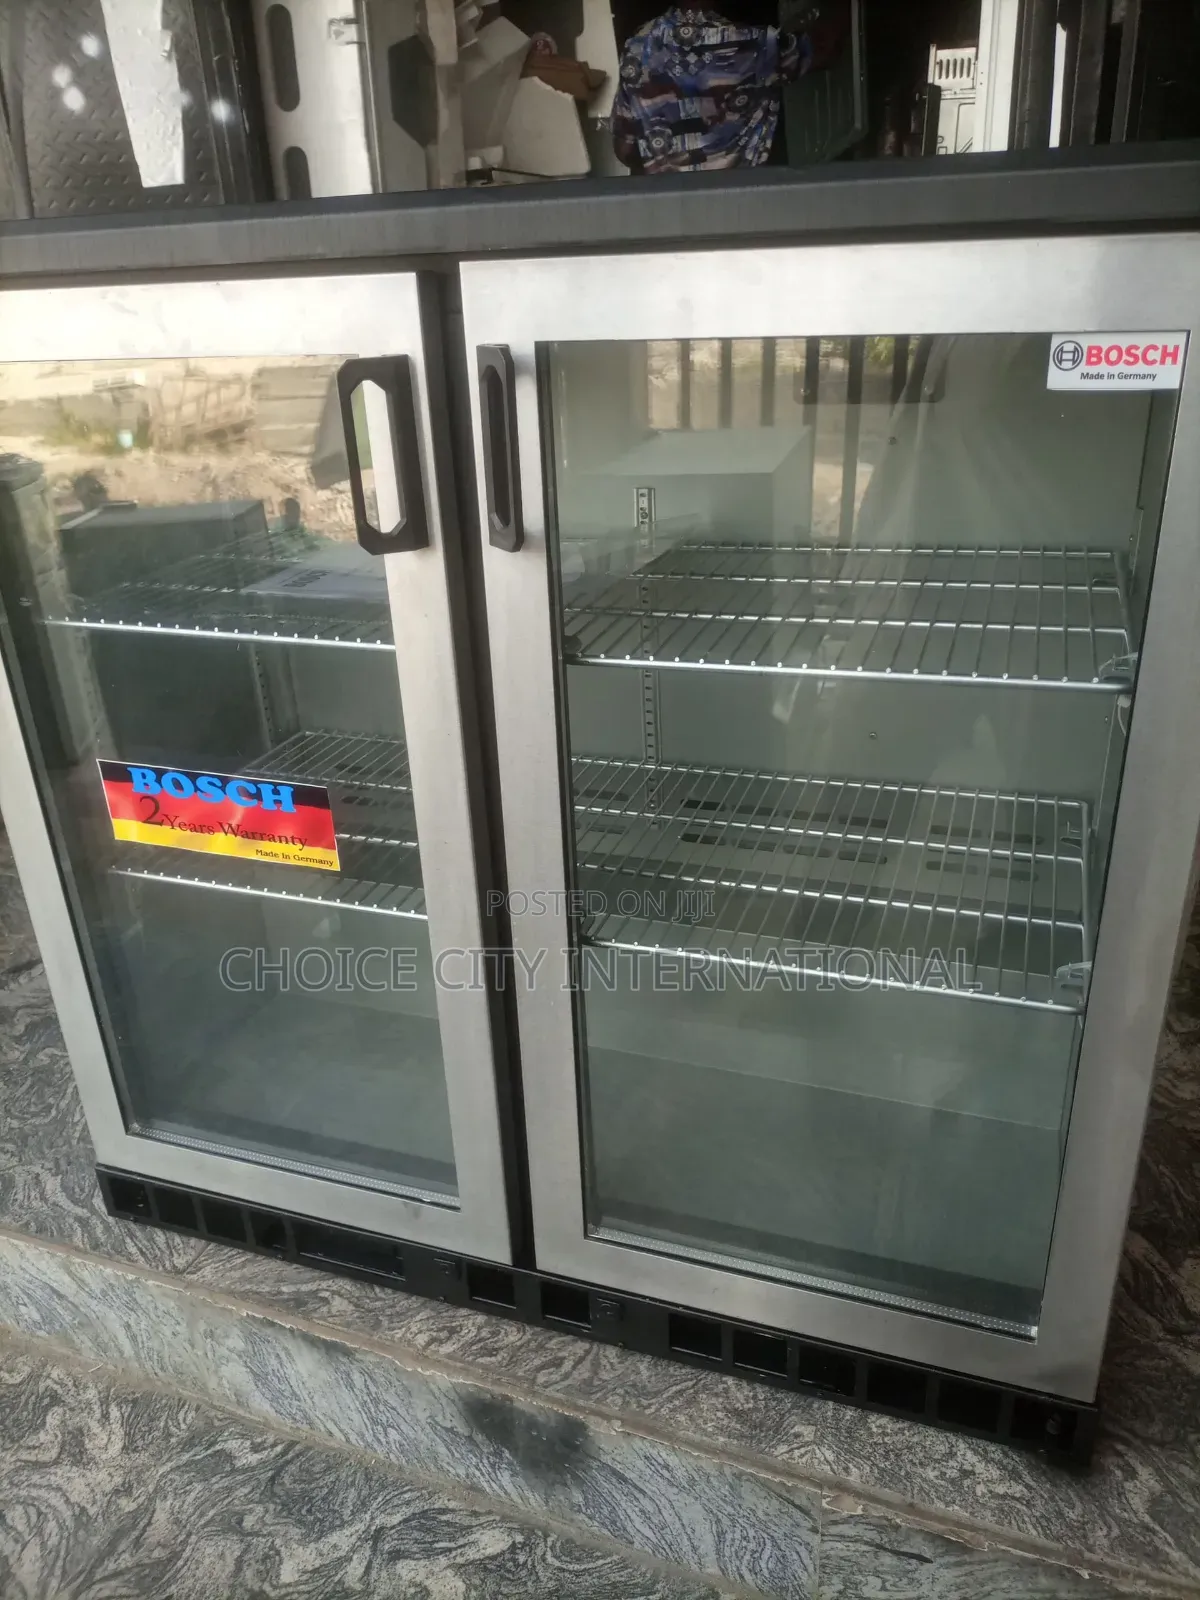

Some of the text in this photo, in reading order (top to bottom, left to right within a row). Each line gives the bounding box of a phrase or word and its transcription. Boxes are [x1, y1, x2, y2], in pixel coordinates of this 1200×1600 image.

[1085, 344, 1180, 366] BOSCH
[1080, 372, 1105, 380] Made
[1117, 372, 1157, 381] Germany
[127, 767, 296, 813] BOSCH
[217, 821, 308, 851] Warranty
[255, 849, 280, 859] Made
[293, 855, 334, 867] Germany
